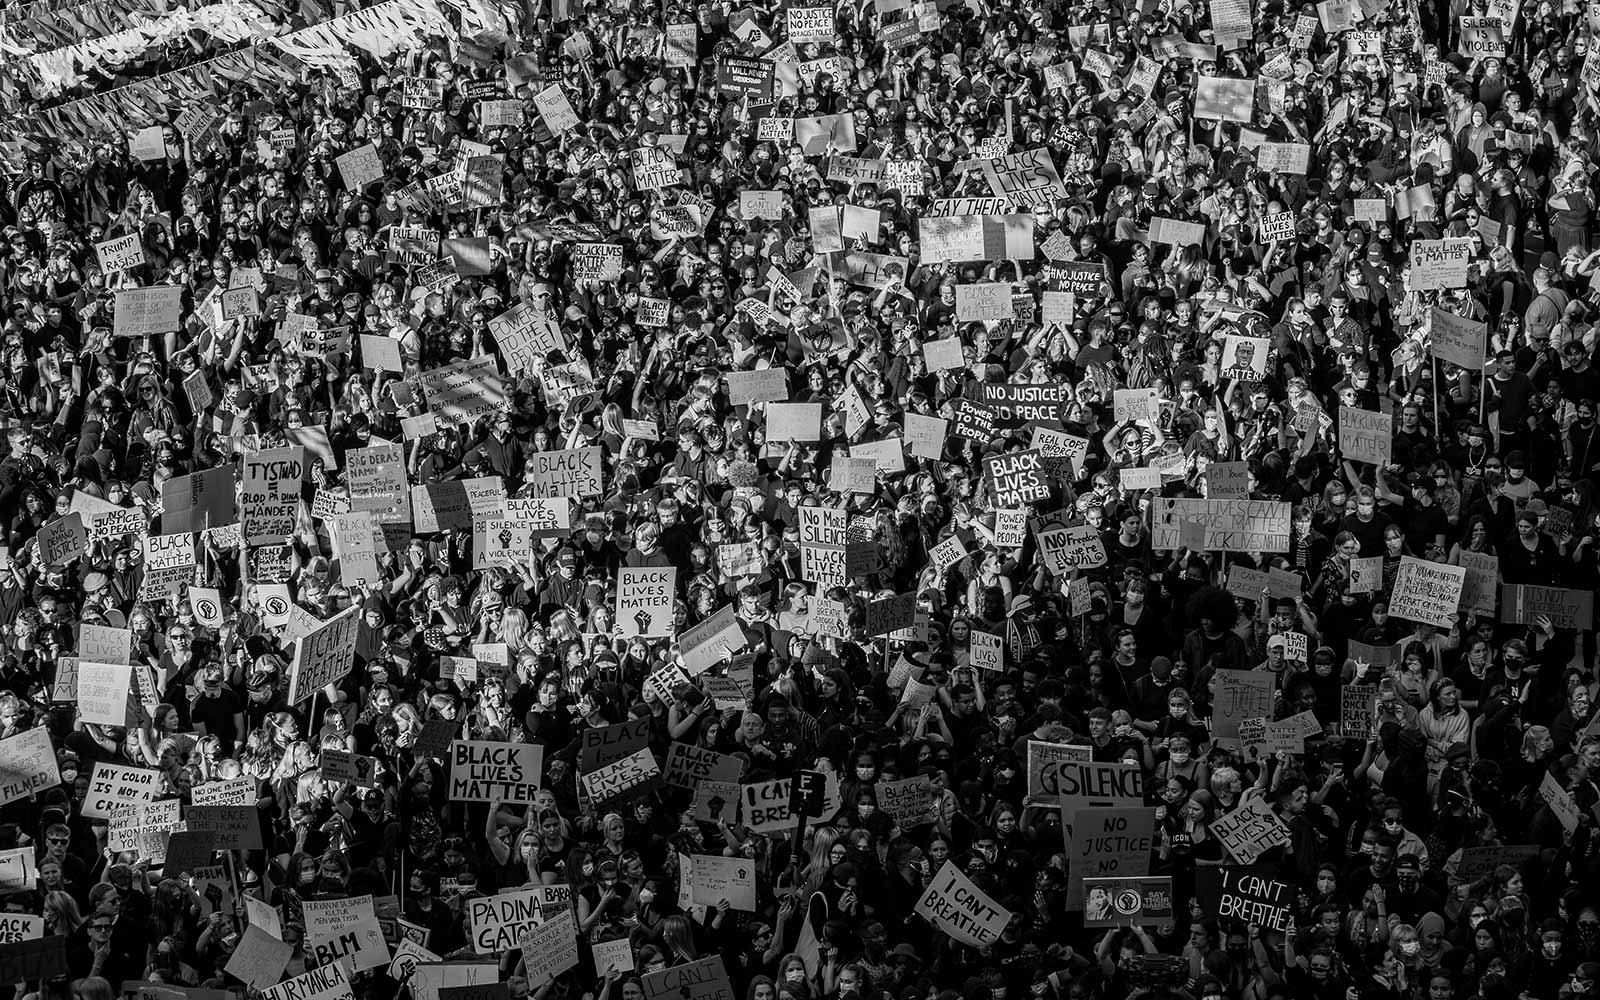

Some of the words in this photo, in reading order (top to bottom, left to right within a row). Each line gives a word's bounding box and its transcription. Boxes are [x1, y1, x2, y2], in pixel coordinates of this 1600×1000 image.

[790, 10, 802, 19] NO
[802, 9, 832, 19] JUSTICE
[790, 20, 802, 28] NO
[804, 20, 829, 28] PEACE
[1463, 18, 1502, 28] SILENCE
[1348, 32, 1378, 40] JUSTICE
[1477, 30, 1488, 38] IS
[1464, 40, 1504, 52] VIOLENCE
[800, 58, 839, 75] BLACK
[760, 118, 778, 126] BLACK
[982, 139, 1006, 147] BLACK
[632, 145, 674, 168] BLACK
[992, 151, 1042, 174] BLACK
[645, 164, 663, 172] LIVES
[888, 160, 923, 175] BLACK
[430, 173, 457, 189] BLACK
[635, 170, 678, 189] MATTER
[998, 166, 1051, 193] LIVES
[1007, 185, 1061, 208] MATTER
[932, 200, 959, 218] SAY
[964, 200, 1005, 216] THEIR
[1262, 212, 1292, 224] BLACK
[1264, 222, 1290, 232] LIVES
[392, 228, 414, 240] BLUE
[416, 230, 439, 243] LIVES
[1261, 229, 1296, 242] MATTER
[101, 237, 135, 256] TRUMP
[576, 246, 601, 256] BLACK
[601, 246, 623, 256] LIVES
[106, 252, 142, 271] RASIST
[397, 251, 437, 265] MURDER
[576, 256, 606, 268] MATTER
[1050, 268, 1067, 280] #NO
[1067, 270, 1100, 282] JUSTICE
[1058, 280, 1072, 290] NO
[1072, 280, 1095, 292] PEACE
[641, 300, 667, 310] BLACK
[644, 308, 664, 316] LIVES
[962, 304, 1010, 317] MATTER
[492, 308, 538, 339] POWER
[639, 315, 666, 324] MATTER
[500, 333, 518, 352] TO
[516, 322, 542, 344] THE
[986, 386, 1004, 401] NO
[1008, 387, 1058, 402] JUSTICE
[434, 412, 463, 426] ENOUGH
[466, 408, 473, 418] IS
[475, 401, 504, 414] ENOUGH
[960, 402, 992, 420] POWER
[1016, 405, 1058, 421] PEACE
[956, 412, 971, 422] TO
[974, 416, 992, 431] THE
[956, 422, 990, 444] PEOPLE
[1038, 433, 1062, 446] REAL
[1064, 438, 1085, 450] COPS
[1342, 432, 1388, 458] MATTER
[1041, 444, 1078, 458] ENFORCE
[349, 452, 367, 470] SÄG
[370, 452, 400, 466] DERAS
[539, 452, 592, 473] BLACK
[989, 454, 1040, 476] BLACK
[248, 461, 301, 480] TYSTNAD
[350, 468, 378, 478] NAMN
[551, 470, 590, 484] LIVES
[993, 471, 1039, 491] LIVES
[243, 493, 265, 504] BLOD
[269, 491, 279, 501] PÅ
[281, 492, 299, 504] DINA
[470, 490, 501, 499] PEACEFUL
[997, 485, 1050, 506] MATTER
[244, 504, 294, 518] HÄNDER
[508, 500, 545, 511] BLACK
[94, 514, 140, 528] JUSTICE
[109, 510, 126, 518] NO
[516, 510, 556, 520] LIVES
[804, 510, 819, 526] NO
[998, 513, 1024, 524] POWER
[1038, 512, 1062, 526] BLM
[51, 526, 65, 536] WE
[96, 527, 108, 536] NO
[110, 522, 140, 534] PEACE
[490, 520, 528, 530] SILENCE
[804, 526, 846, 546] SILENCE
[997, 531, 1022, 544] PEOPLE
[48, 536, 80, 564] JUSTICE
[150, 534, 191, 554] BLACK
[150, 552, 194, 568] MATTER.
[489, 549, 527, 558] VIOLENCE
[806, 548, 846, 564] BLACK
[807, 562, 842, 574] LIVES
[624, 572, 668, 584] BLACK
[806, 572, 844, 586] MATTER
[624, 586, 664, 596] LIVES
[621, 596, 669, 609] MATTER
[83, 628, 124, 644] BLACK
[971, 632, 993, 648] BLACK
[86, 644, 123, 656] LIVES
[306, 638, 314, 665] I
[974, 648, 996, 663] LIVES
[298, 645, 352, 698] BREATHE
[1343, 710, 1371, 721] BLACK
[456, 745, 520, 766] BLACK
[675, 746, 720, 766] BLACK
[470, 764, 523, 781] LIVES
[588, 752, 646, 785] BLACK
[671, 757, 712, 776] LIVES
[98, 769, 118, 780] MY
[122, 772, 152, 785] COLOR
[590, 766, 643, 795] LIVES
[1060, 763, 1142, 798] SILENCE
[2, 774, 48, 799] FILMED
[94, 782, 112, 794] IS
[118, 787, 138, 798] NOT
[142, 791, 150, 800] A
[210, 786, 222, 795] ONE
[232, 780, 248, 791] FREE
[453, 778, 538, 801] MATTER
[110, 807, 137, 818] PEOPLE
[144, 804, 161, 814] ASK
[164, 803, 177, 812] ME
[108, 819, 129, 829] WHY
[1104, 818, 1127, 832] NO
[1214, 806, 1260, 839] BLACK
[1172, 834, 1190, 842] ICON
[1224, 820, 1265, 849] LIVES
[1083, 837, 1149, 856] JUSTICE
[1236, 826, 1291, 864] MATTER
[1099, 859, 1118, 872] NO
[194, 867, 223, 880] #BLM
[545, 888, 570, 901] BARA
[1238, 876, 1288, 902] CAN'T
[474, 898, 498, 926] PÅ
[502, 896, 542, 922] DINA
[316, 932, 362, 968] BLM
[648, 980, 656, 996] I
